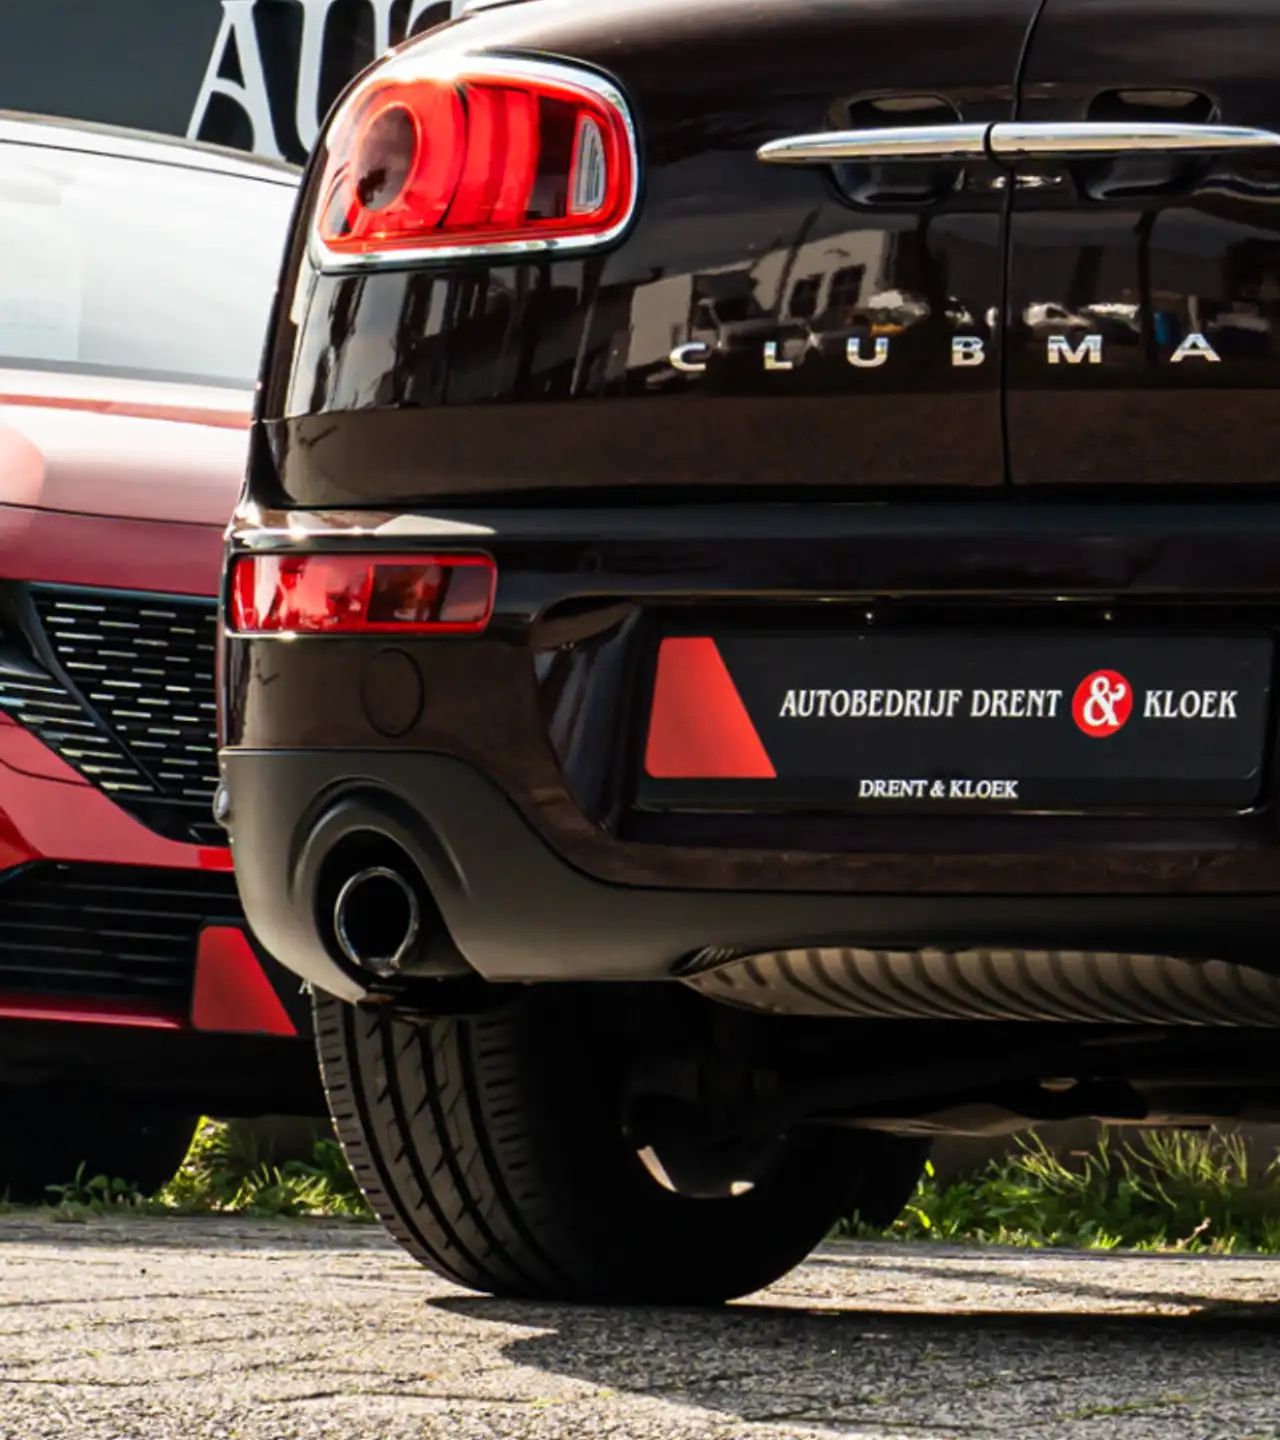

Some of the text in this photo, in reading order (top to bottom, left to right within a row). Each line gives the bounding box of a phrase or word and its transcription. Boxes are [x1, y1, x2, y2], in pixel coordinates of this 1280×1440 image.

[780, 675, 1239, 727] AUTOBEDRIJF DRENT & KLOEK
[859, 779, 1019, 800] DRENT & KLOEK
